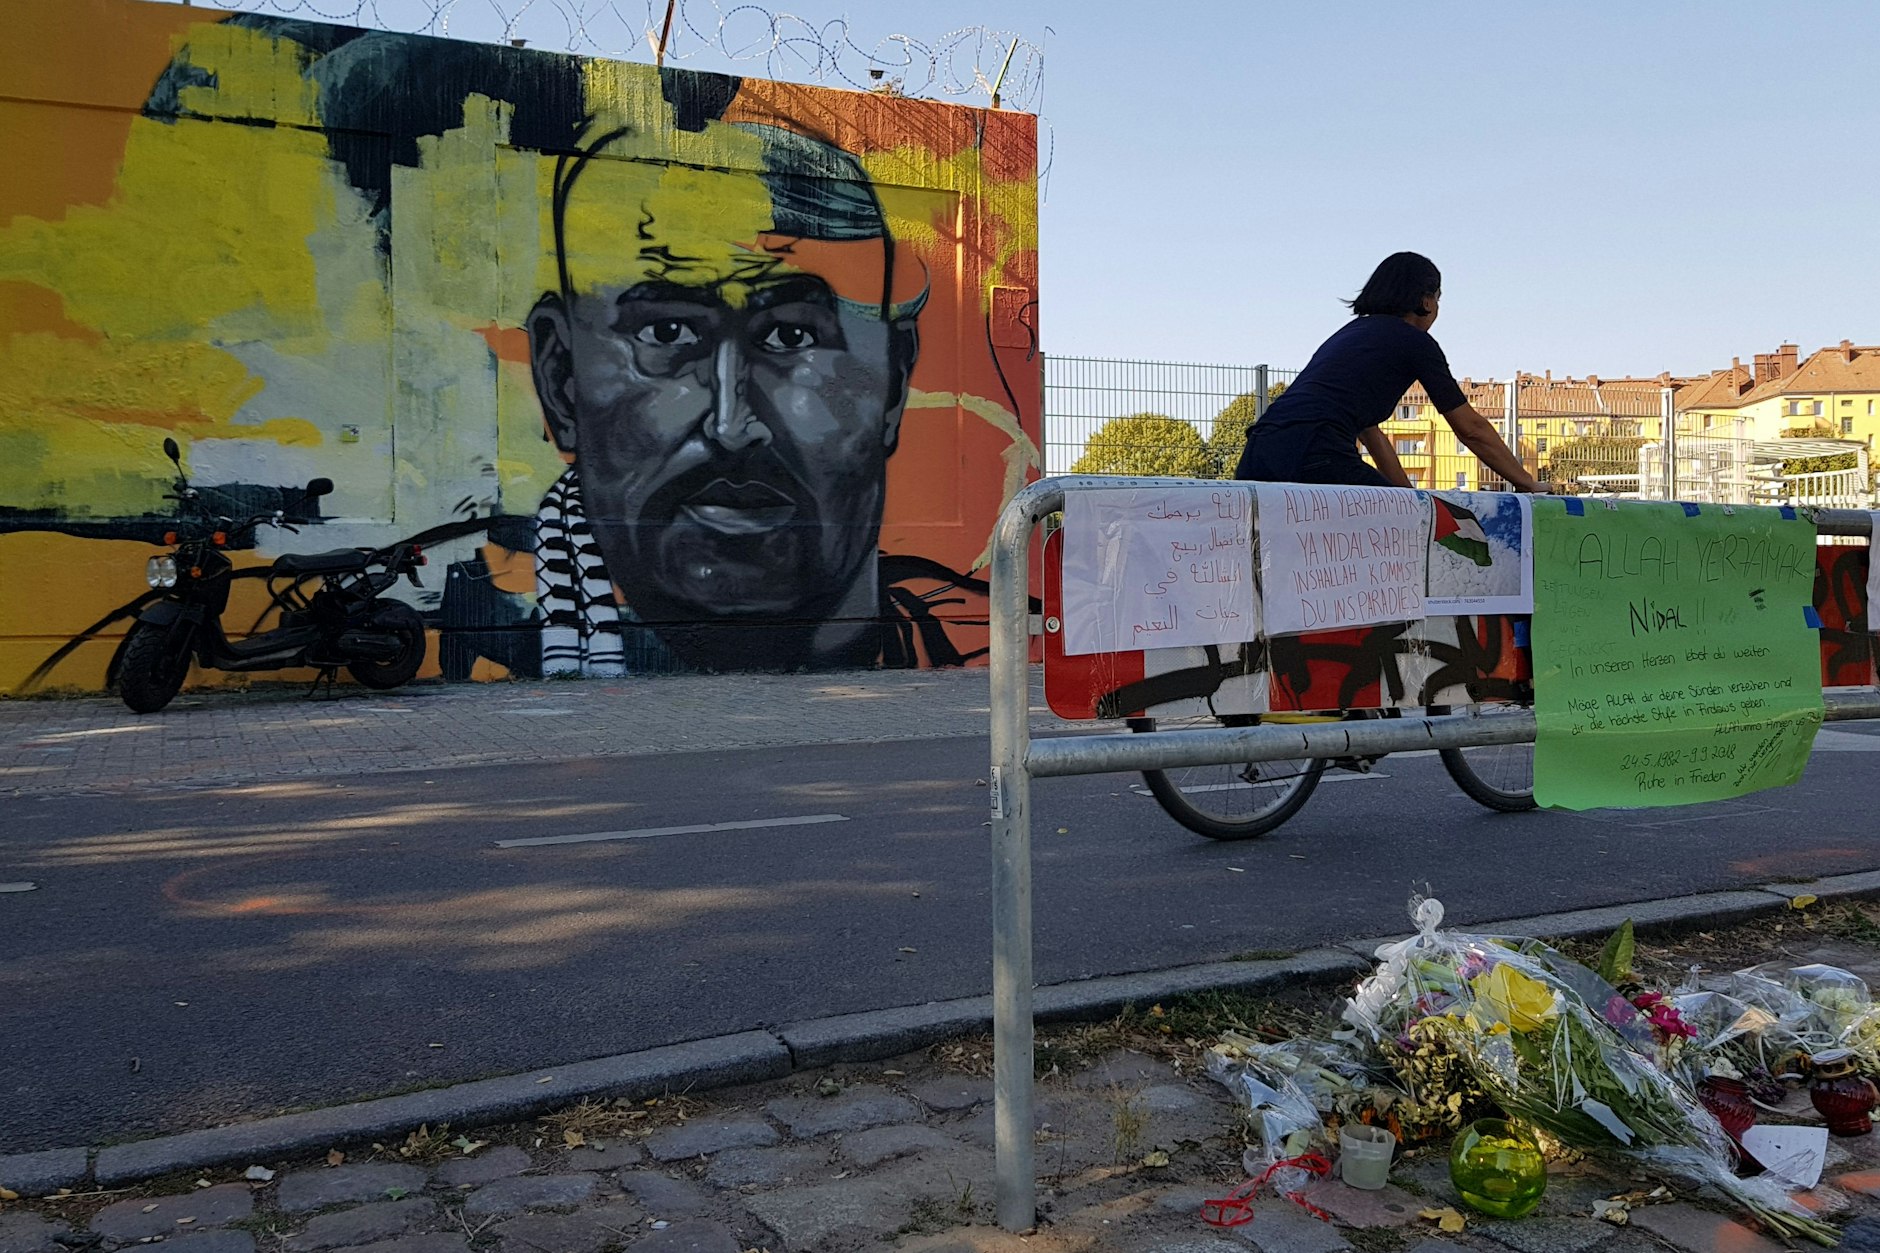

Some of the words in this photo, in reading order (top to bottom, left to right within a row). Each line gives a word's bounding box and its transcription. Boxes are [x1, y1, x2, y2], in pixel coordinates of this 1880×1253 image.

[1148, 501, 1200, 522] يرحمك
[1212, 491, 1246, 522] الله
[1284, 489, 1329, 524] ALLAH
[1171, 540, 1203, 562] ربيع
[1296, 532, 1319, 566] YA
[1322, 531, 1368, 563] NIDAL
[1367, 527, 1420, 559] RABIH
[1579, 533, 1679, 585] ALLAH
[1144, 568, 1178, 600] في
[1293, 564, 1357, 594] INSHALLAH
[1369, 561, 1420, 585] KOMMST
[1196, 598, 1240, 620] جنات
[1301, 596, 1327, 628] DU
[1334, 596, 1356, 623] INS
[1357, 583, 1421, 622] PARADIES
[1133, 604, 1179, 646] النعيم
[1570, 658, 1584, 679] In
[1590, 659, 1635, 675] unseren
[1642, 651, 1676, 669] Herzen
[1713, 645, 1726, 660] du
[1568, 697, 1600, 719] Möge
[1606, 691, 1637, 707] ALLAH
[1641, 690, 1654, 703] dir
[1659, 689, 1686, 701] deine
[1688, 682, 1724, 699] Sünden
[1728, 679, 1770, 694] verzeihen
[1773, 676, 1792, 689] und
[1571, 722, 1584, 736] dir
[1590, 718, 1606, 731] die
[1609, 709, 1649, 727] höchste
[1651, 705, 1678, 724] Stufe
[1683, 705, 1695, 717] in
[1695, 702, 1737, 717] Firdaws
[1634, 771, 1666, 793] Ruhe
[1674, 774, 1685, 787] in
[1689, 768, 1727, 784] Frieden
